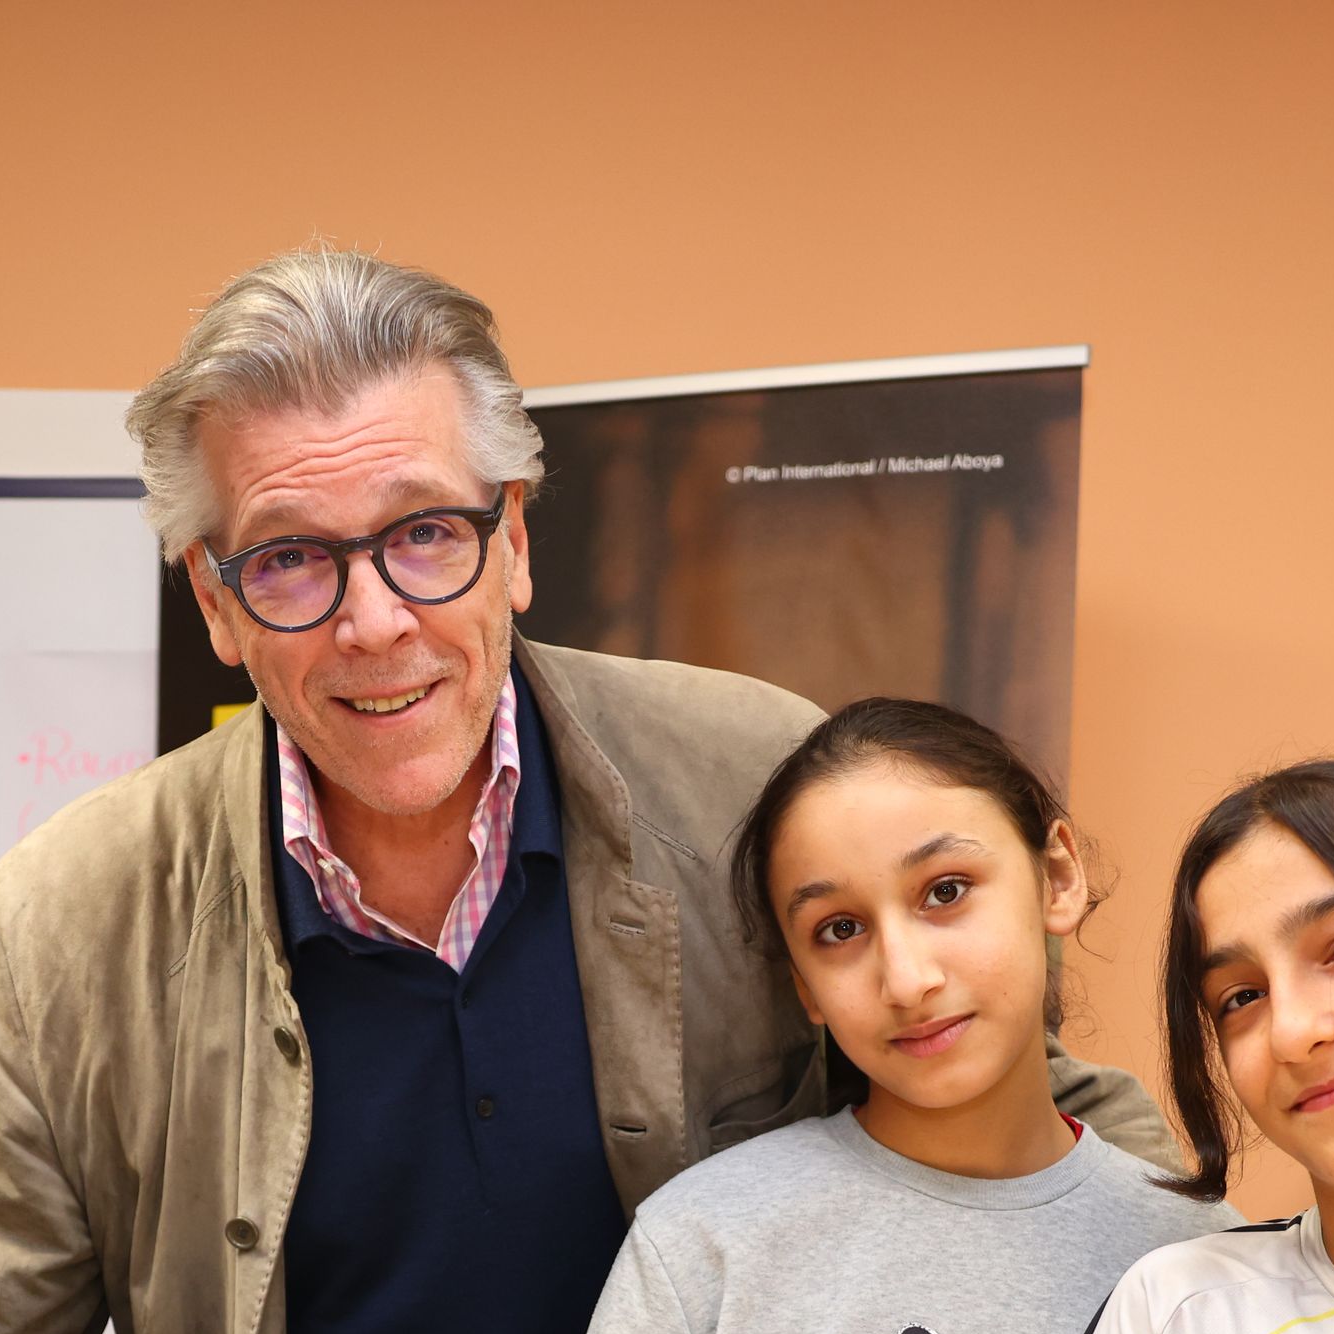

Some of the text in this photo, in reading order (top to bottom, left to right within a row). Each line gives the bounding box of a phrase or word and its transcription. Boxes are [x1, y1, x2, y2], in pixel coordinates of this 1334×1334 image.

[742, 465, 779, 482] Plan
[781, 458, 875, 479] International
[887, 455, 949, 474] Michael
[951, 453, 1004, 472] Aboya
